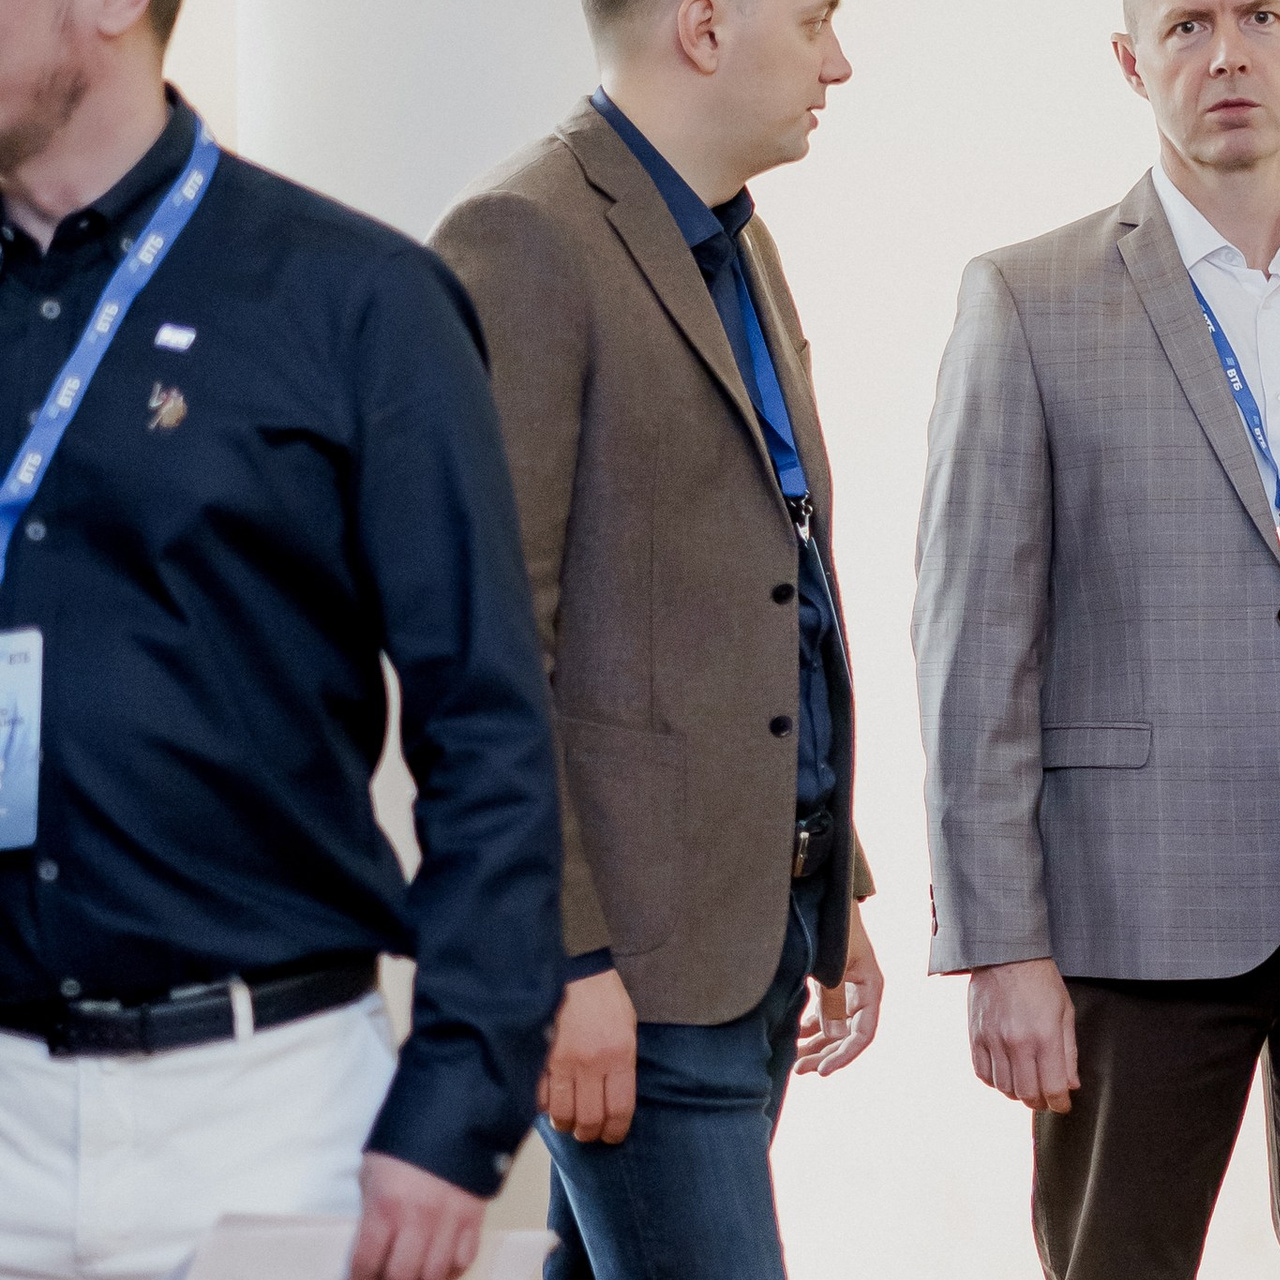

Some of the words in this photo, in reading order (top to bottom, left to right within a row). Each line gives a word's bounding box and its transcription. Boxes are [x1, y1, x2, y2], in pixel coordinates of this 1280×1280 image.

[182, 170, 204, 200] ВТБ
[138, 234, 164, 265] ВТБ
[57, 377, 81, 409] ВТБ
[1226, 368, 1243, 392] ВТБ
